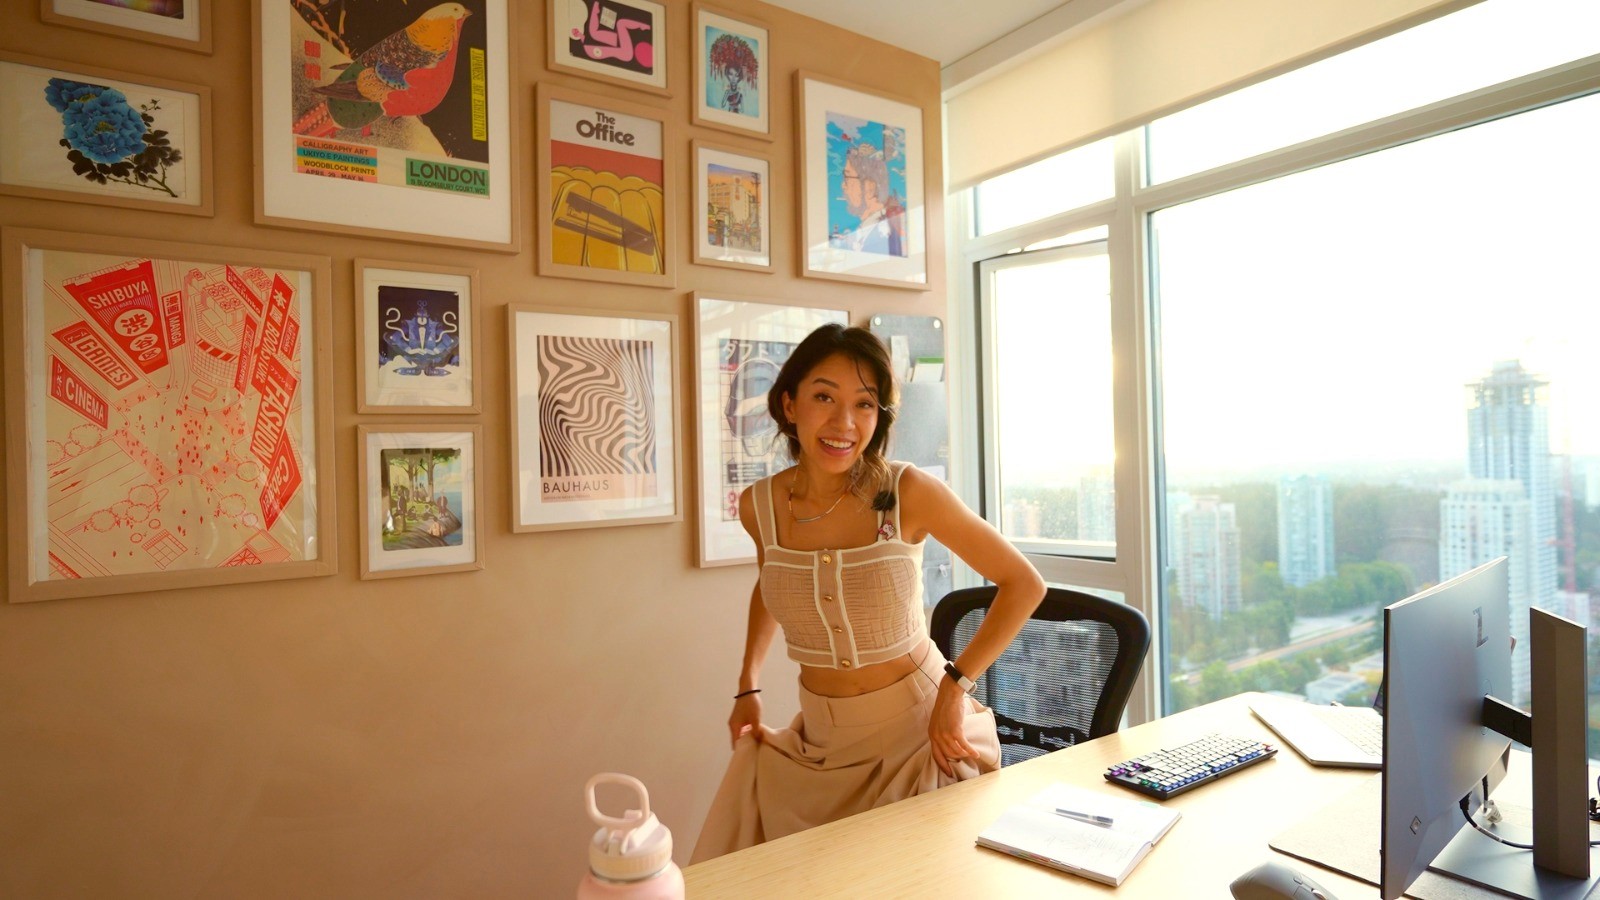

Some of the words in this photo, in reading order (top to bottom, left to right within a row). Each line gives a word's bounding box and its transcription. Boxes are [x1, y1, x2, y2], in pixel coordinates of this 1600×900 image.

[595, 111, 616, 125] The
[576, 119, 635, 146] Office
[303, 140, 353, 153] CALLIGRAPHY
[333, 153, 370, 165] PAINTINGS
[303, 160, 349, 172] WOODBLOCK
[351, 166, 376, 176] PRINTS
[410, 161, 486, 186] LONDON
[87, 280, 150, 309] SHIBUYA
[169, 315, 182, 346] MANGA
[76, 338, 130, 385] GAMES
[256, 321, 280, 384] BOOKSTORE
[65, 377, 105, 422] CINEMA
[252, 374, 291, 465] FASHION
[543, 480, 609, 493] BAUHAUS
